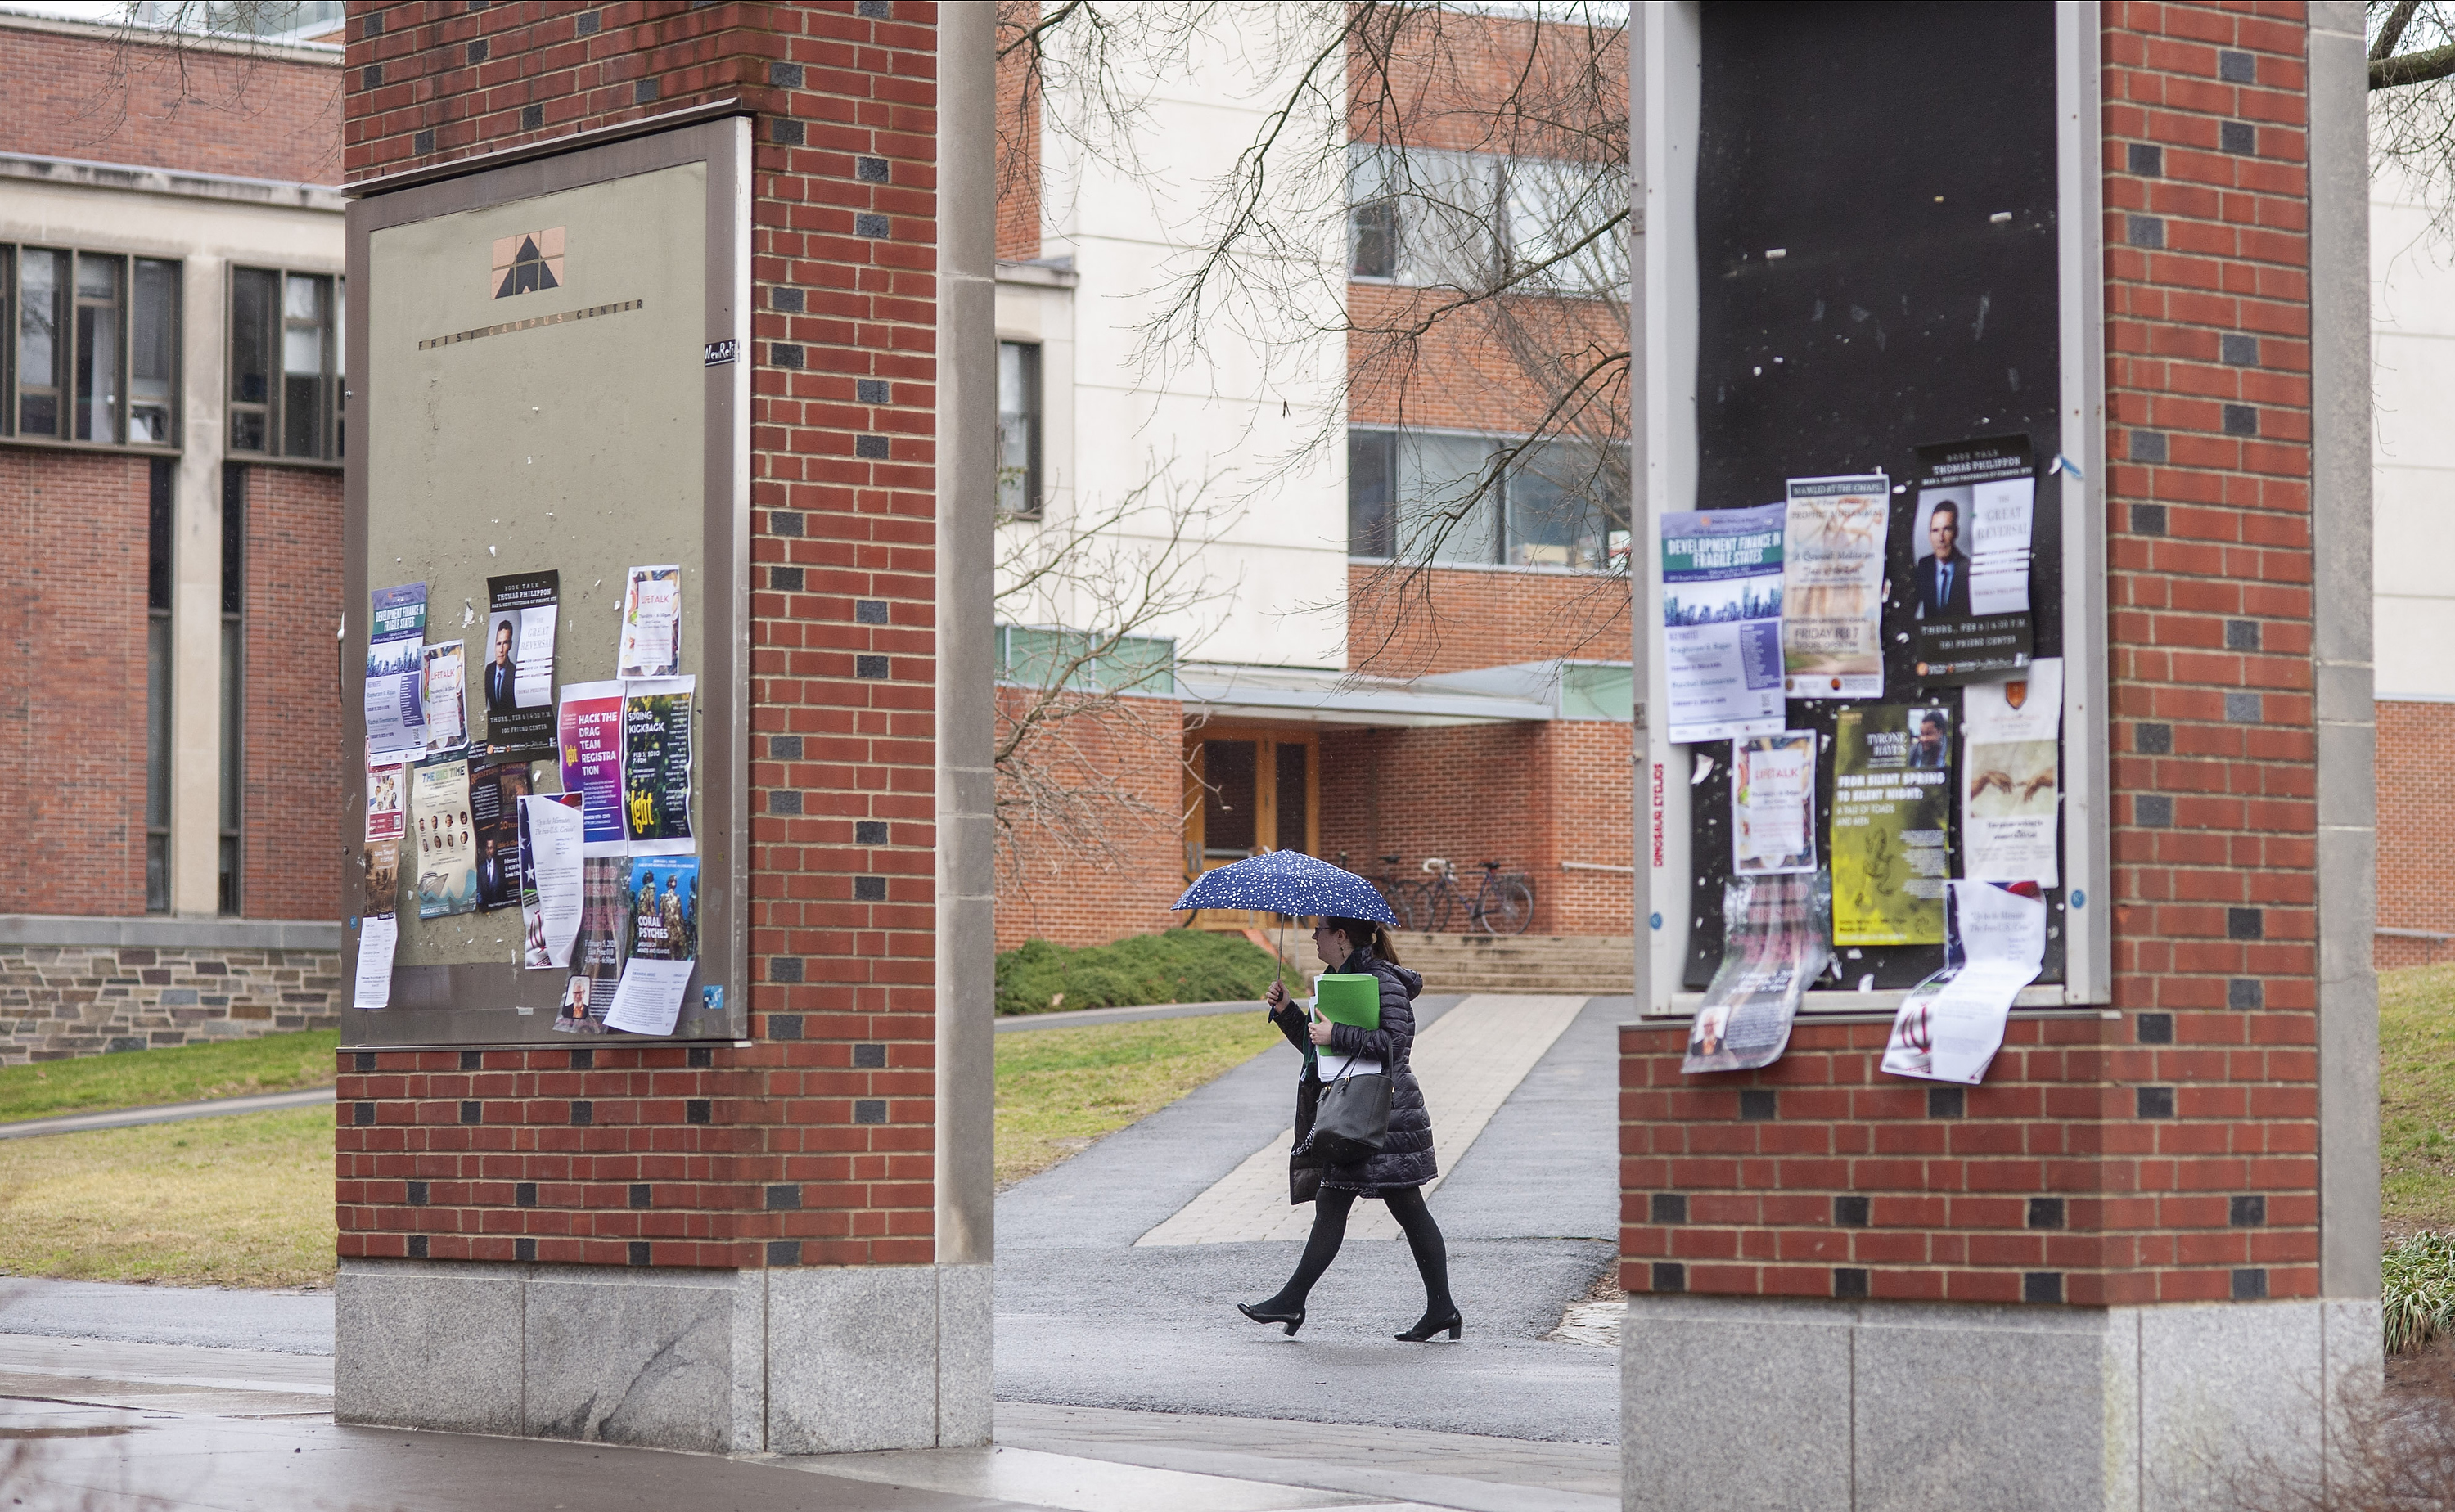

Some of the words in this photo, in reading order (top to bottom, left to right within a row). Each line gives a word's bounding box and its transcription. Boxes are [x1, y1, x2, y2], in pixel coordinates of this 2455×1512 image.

[418, 330, 475, 350] FRIST
[489, 313, 564, 335] CAMPUS
[576, 299, 643, 320] CENTER
[1946, 452, 1971, 462] BOOK
[1975, 450, 1999, 459] TALK
[1932, 461, 1971, 475] THOMAS
[1972, 456, 2020, 470] PHILIPPON
[1838, 484, 1851, 492] THE
[1987, 507, 2022, 521] GREAT
[1977, 524, 2027, 540] REVERSAL
[1668, 537, 1737, 556] DEVELOPMENT
[1737, 533, 1772, 551] FINANCE
[1773, 531, 1782, 547] IN
[1692, 551, 1732, 568] FRAGILE
[1732, 548, 1764, 566] STATES
[497, 592, 518, 601] THOMAS
[520, 588, 552, 598] PHILIPPON
[376, 607, 403, 623] DEVELOPMENT
[403, 604, 419, 618] FINANCE
[419, 603, 425, 614] IN
[384, 619, 399, 632] FRAGILE
[399, 616, 415, 629] STATES
[528, 626, 549, 637] GREAT
[1795, 627, 1832, 639] FRIDAY
[520, 638, 552, 650] REVERSAL
[1956, 637, 1985, 648] FRIEND
[1985, 635, 2017, 646] CENTER
[430, 668, 455, 681] LIFETALK
[490, 715, 511, 723] THURS.,
[579, 713, 600, 725] HACK
[601, 711, 618, 722] THE
[628, 710, 653, 722] SPRING
[529, 723, 547, 731] CENTER
[579, 727, 600, 737] DRAG
[628, 722, 665, 734] KICKBACK
[579, 739, 601, 750] TEAM
[1866, 731, 1908, 746] TYRONE
[581, 751, 616, 763] REGISTRA
[421, 771, 435, 783] THE
[435, 769, 448, 781] BIG
[449, 765, 466, 778] TIME
[582, 765, 600, 776] TION
[1755, 767, 1799, 781] LIFETALK
[1837, 775, 1866, 789] FROM
[1866, 772, 1901, 787] SILENT
[1901, 771, 1946, 785] SPRING
[1836, 790, 1851, 803] TO
[1851, 788, 1885, 802] SILENT
[1885, 787, 1924, 801] NIGHT:
[1859, 804, 1870, 814] OF
[1871, 803, 1895, 814] TOADS
[1835, 817, 1852, 827] AND
[1853, 816, 1870, 826] MEN
[1654, 811, 1663, 867] DINOSAUR
[637, 916, 661, 928] CORAL
[638, 927, 669, 939] PSYCHES
